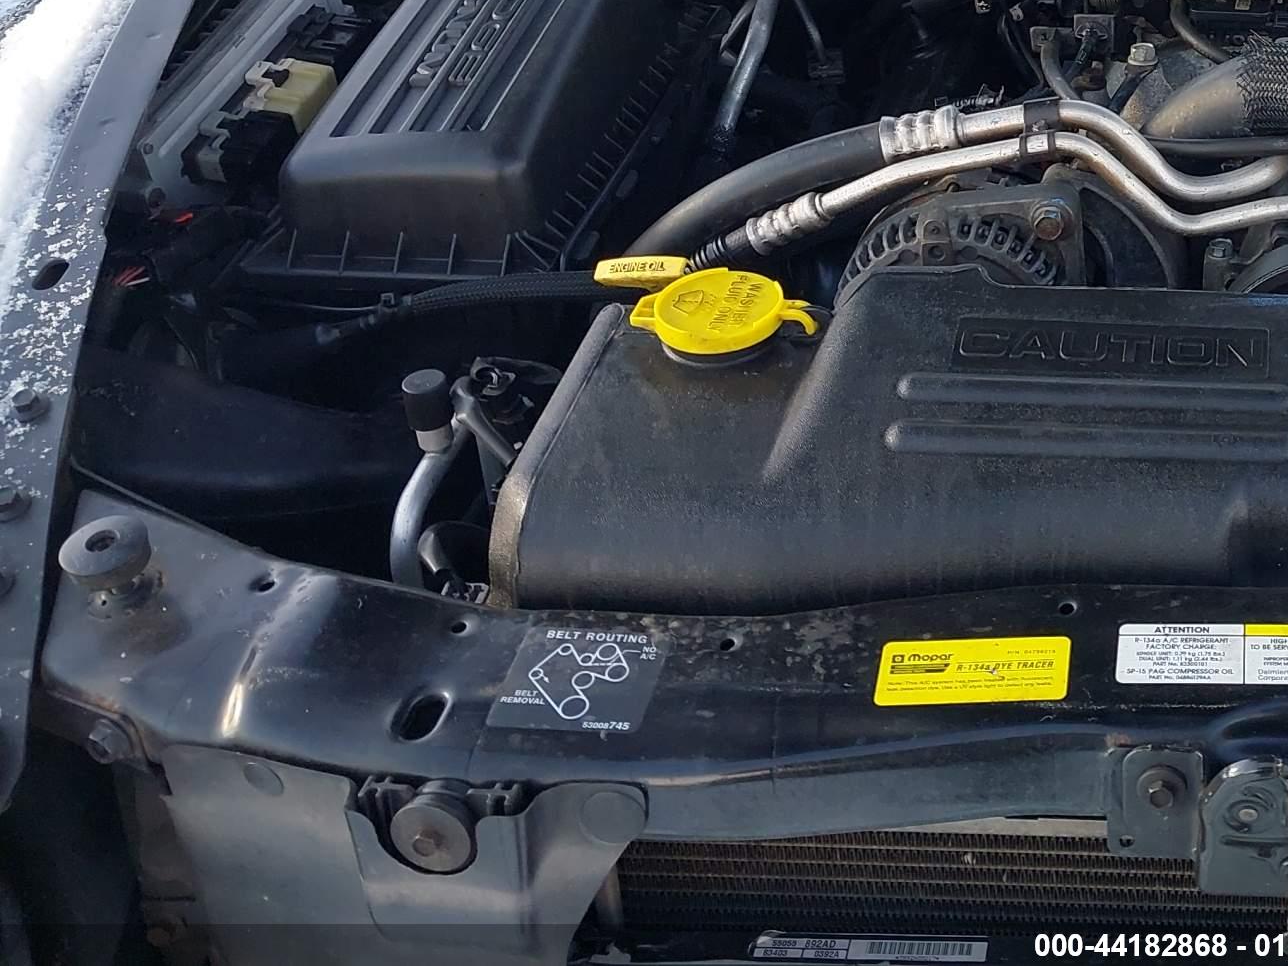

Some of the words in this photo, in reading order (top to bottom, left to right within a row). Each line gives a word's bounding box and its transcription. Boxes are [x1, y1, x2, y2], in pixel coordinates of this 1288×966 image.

[608, 261, 646, 274] ENGINE
[647, 260, 666, 271] OIL
[724, 274, 751, 309] FLUID
[707, 305, 732, 333] ONLY
[957, 329, 1265, 368] CAUTION
[547, 630, 581, 640] BELT
[585, 632, 649, 644] ROUTING
[1154, 626, 1210, 634] ATTENTION
[993, 662, 1013, 670] DYE
[1016, 661, 1055, 670] TRACER
[500, 696, 546, 705] REMOVAL
[805, 939, 836, 949] 892AD
